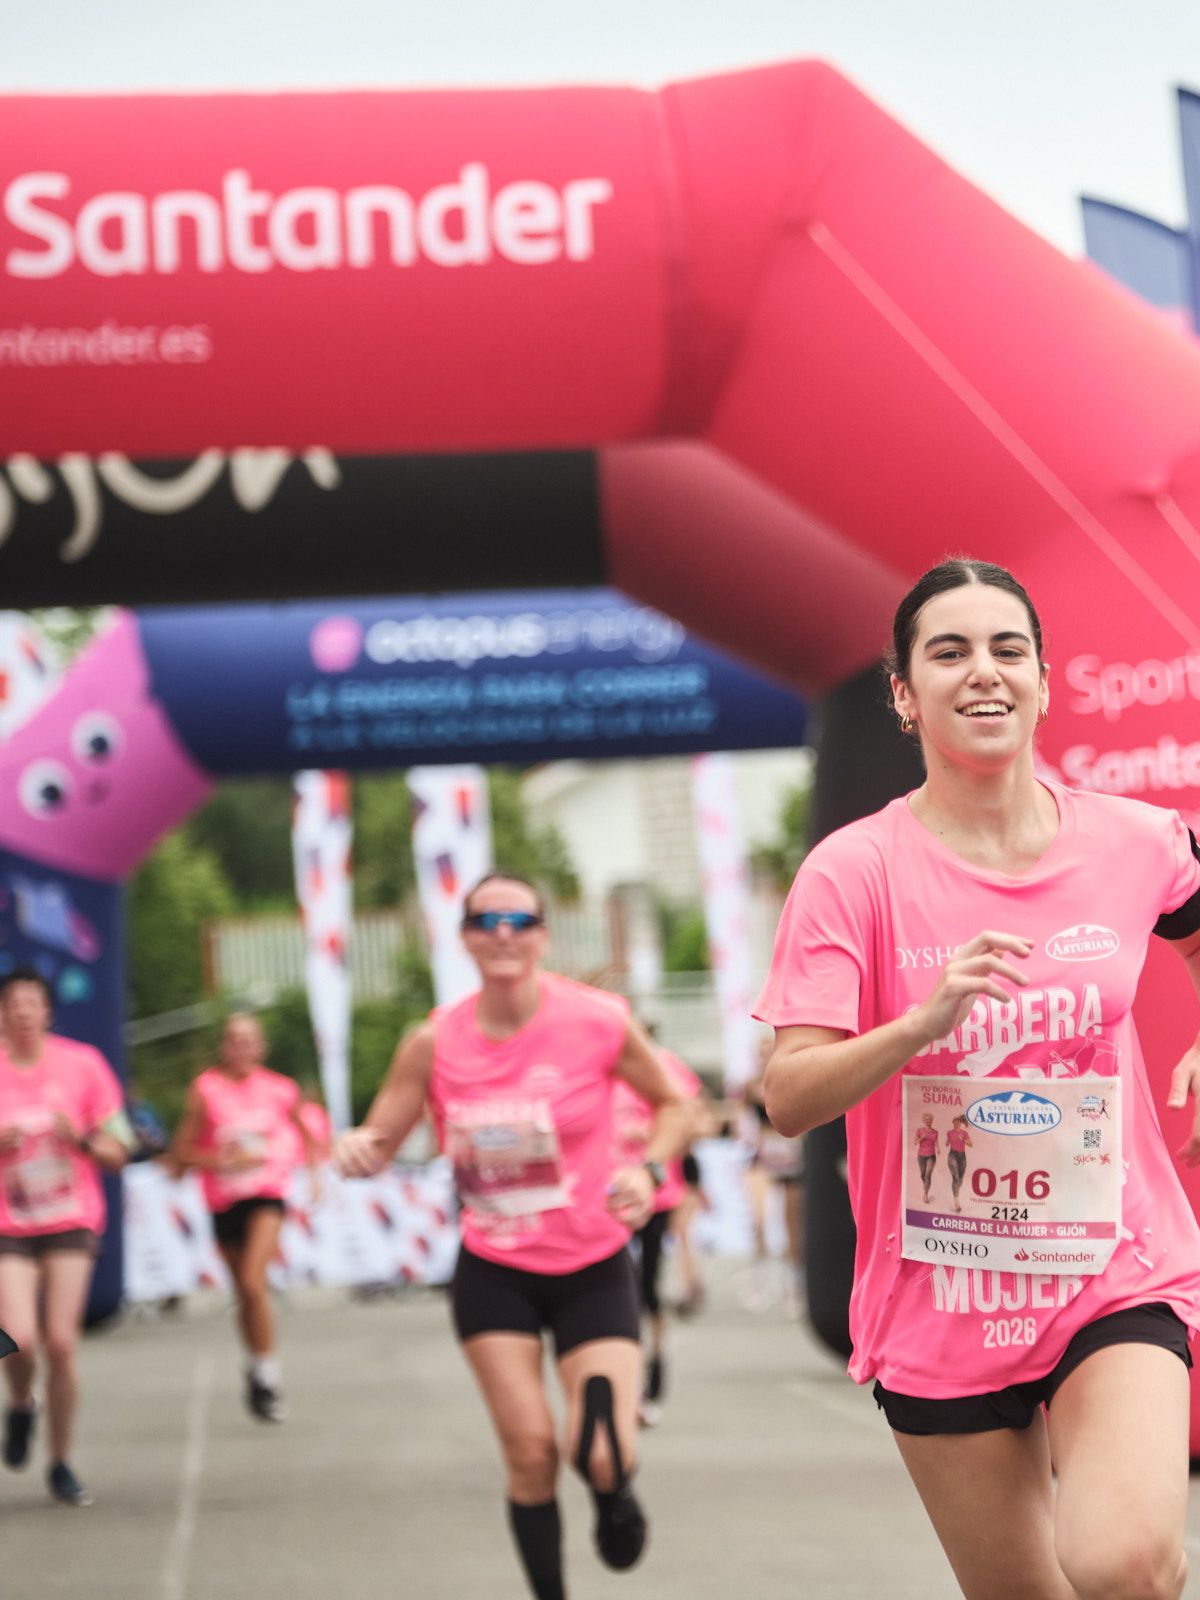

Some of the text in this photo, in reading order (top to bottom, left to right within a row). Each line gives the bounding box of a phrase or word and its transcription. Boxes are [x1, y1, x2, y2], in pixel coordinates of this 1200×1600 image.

[3, 161, 614, 280] Santander
[923, 1093, 963, 1107] SUMA
[973, 1105, 1055, 1125] ASTURIANA
[971, 1168, 1051, 1201] 016
[991, 1206, 1029, 1221] 2124
[932, 1217, 977, 1232] CARRERA
[981, 1223, 993, 1234] DE
[996, 1224, 1009, 1235] LA
[1012, 1225, 1048, 1237] MUJER
[1056, 1224, 1087, 1237] GIJÓN
[925, 1238, 989, 1259] OYSHO
[1032, 1251, 1096, 1264] Santander
[982, 1317, 1037, 1349] 2026
